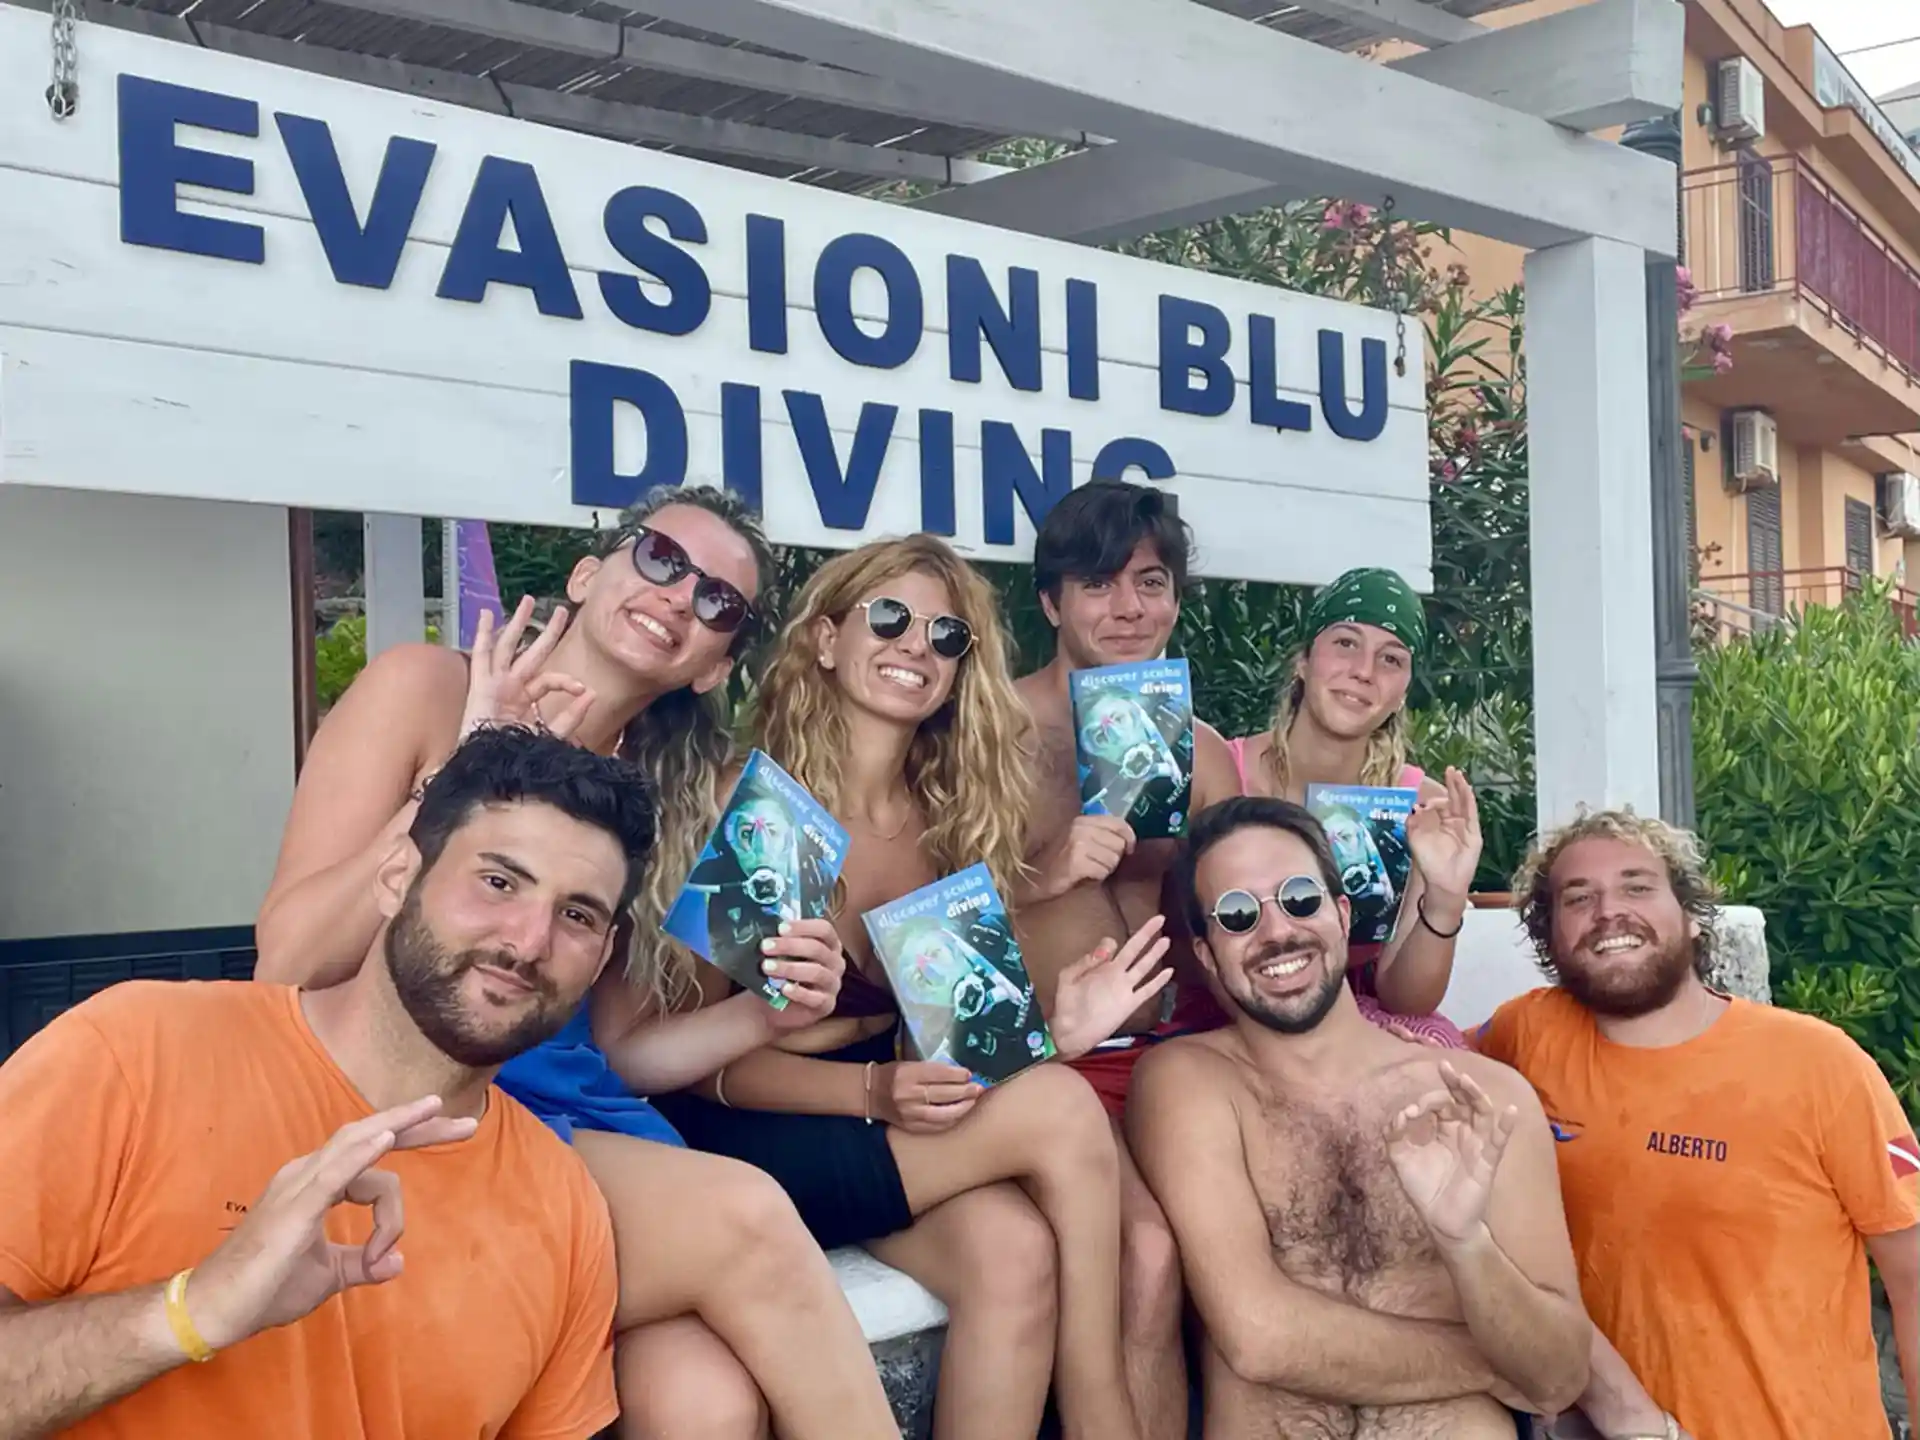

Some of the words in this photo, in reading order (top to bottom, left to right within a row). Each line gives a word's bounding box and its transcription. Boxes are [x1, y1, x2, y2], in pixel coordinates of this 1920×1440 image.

[117, 73, 1099, 402] EVASIONI
[1158, 294, 1389, 442] BLU
[1081, 671, 1137, 690] discover
[1142, 667, 1182, 681] scuba
[1140, 682, 1183, 697] diving
[878, 892, 939, 929] discover
[943, 876, 984, 899] scuba
[946, 891, 991, 919] diving
[1646, 1131, 1728, 1163] ALBERTO
